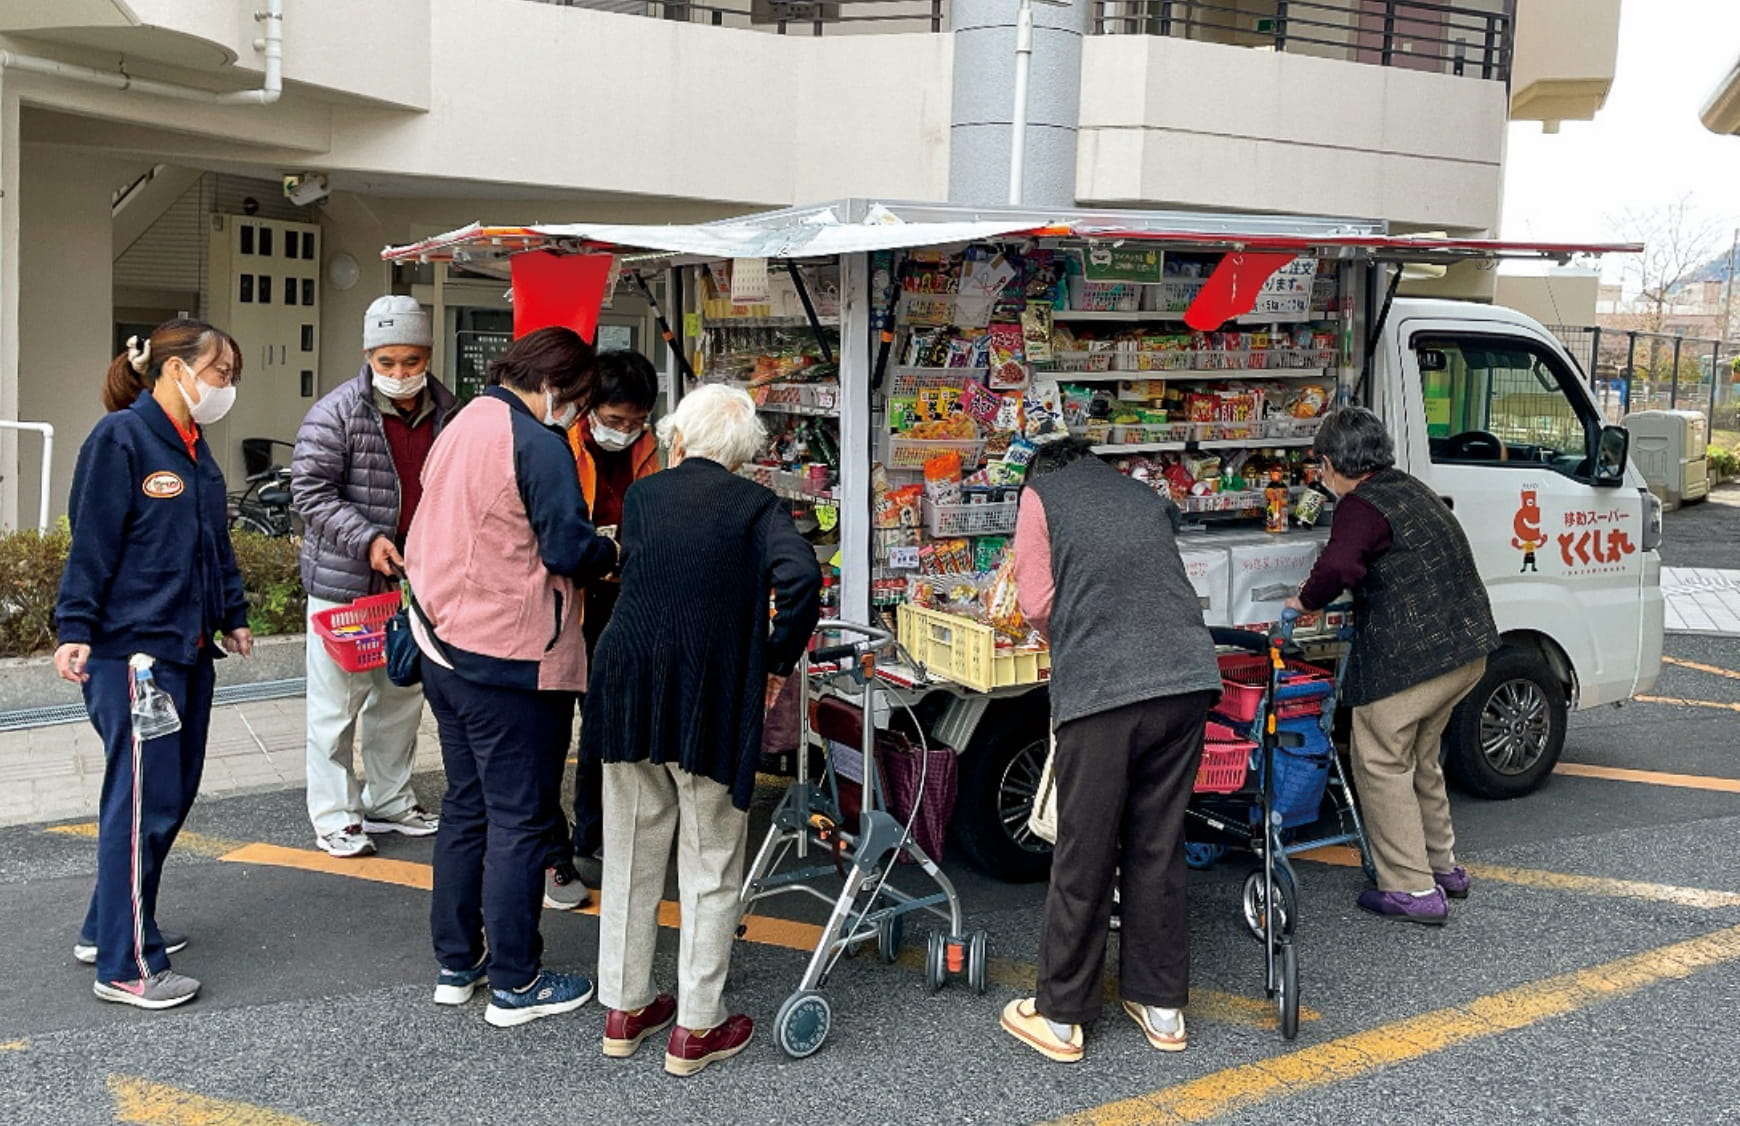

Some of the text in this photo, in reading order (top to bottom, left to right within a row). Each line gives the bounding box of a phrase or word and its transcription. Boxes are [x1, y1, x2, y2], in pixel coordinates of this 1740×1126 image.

[1564, 509, 1629, 527] 移動スーパー
[1557, 529, 1636, 566] とくし丸
